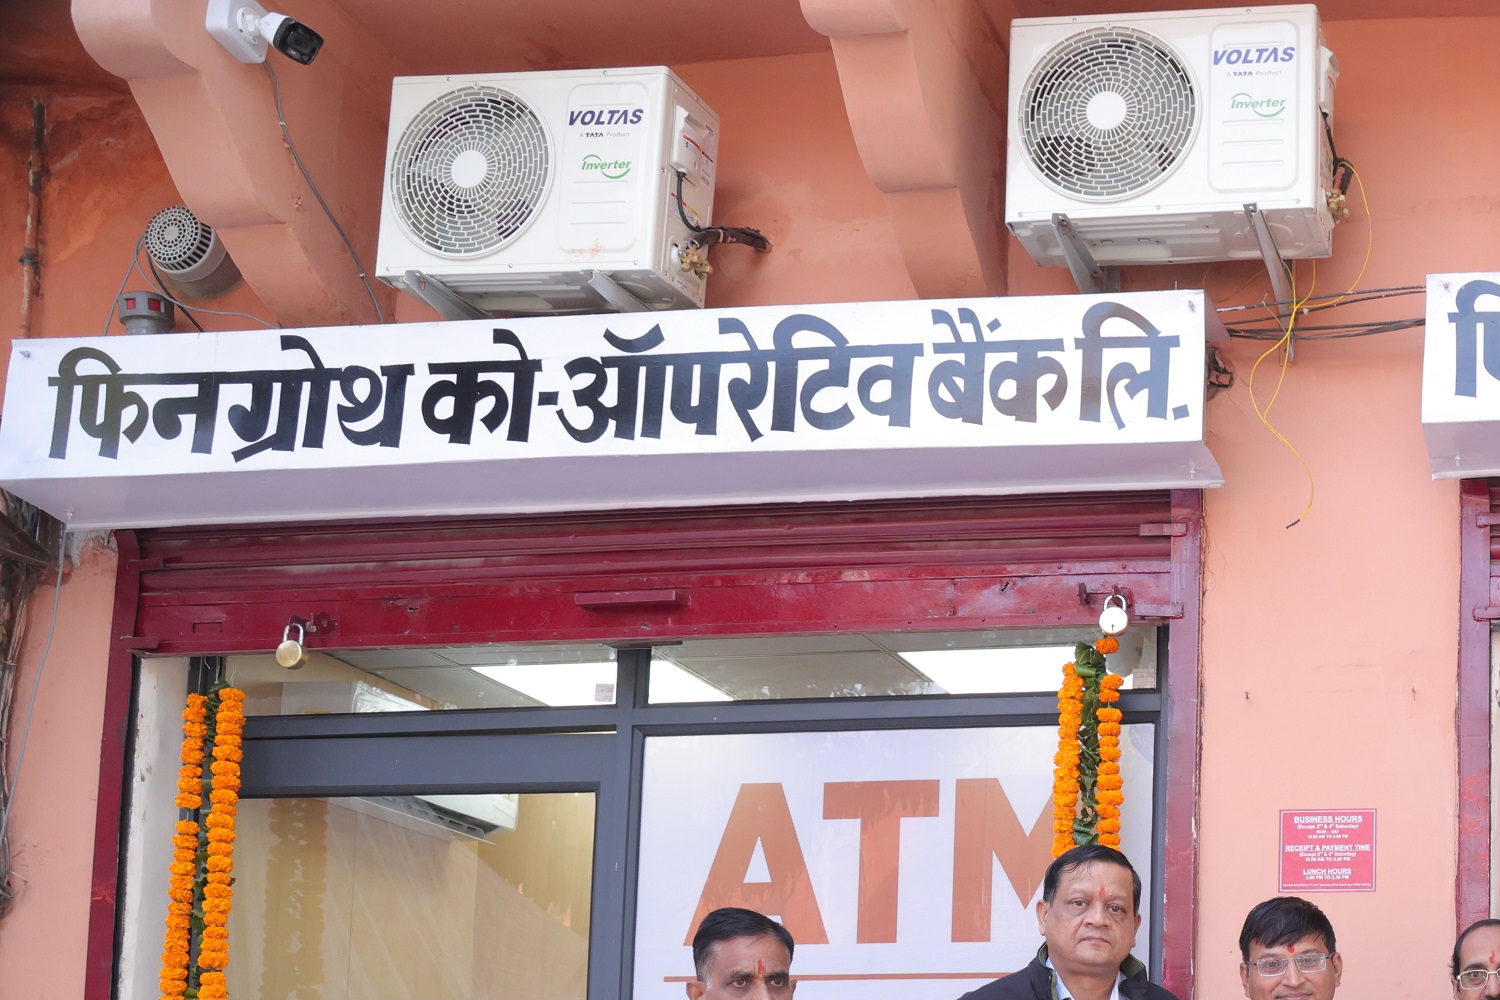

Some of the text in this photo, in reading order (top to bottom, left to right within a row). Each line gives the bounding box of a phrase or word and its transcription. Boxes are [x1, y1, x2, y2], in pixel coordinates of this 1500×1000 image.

[1213, 47, 1295, 65] VOLTAS
[568, 108, 644, 126] VOLTAS
[48, 334, 415, 463] फिनग्रोथ
[928, 307, 1067, 424] बैंक
[1335, 815, 1363, 823] HOURS
[682, 778, 1104, 947] ATM
